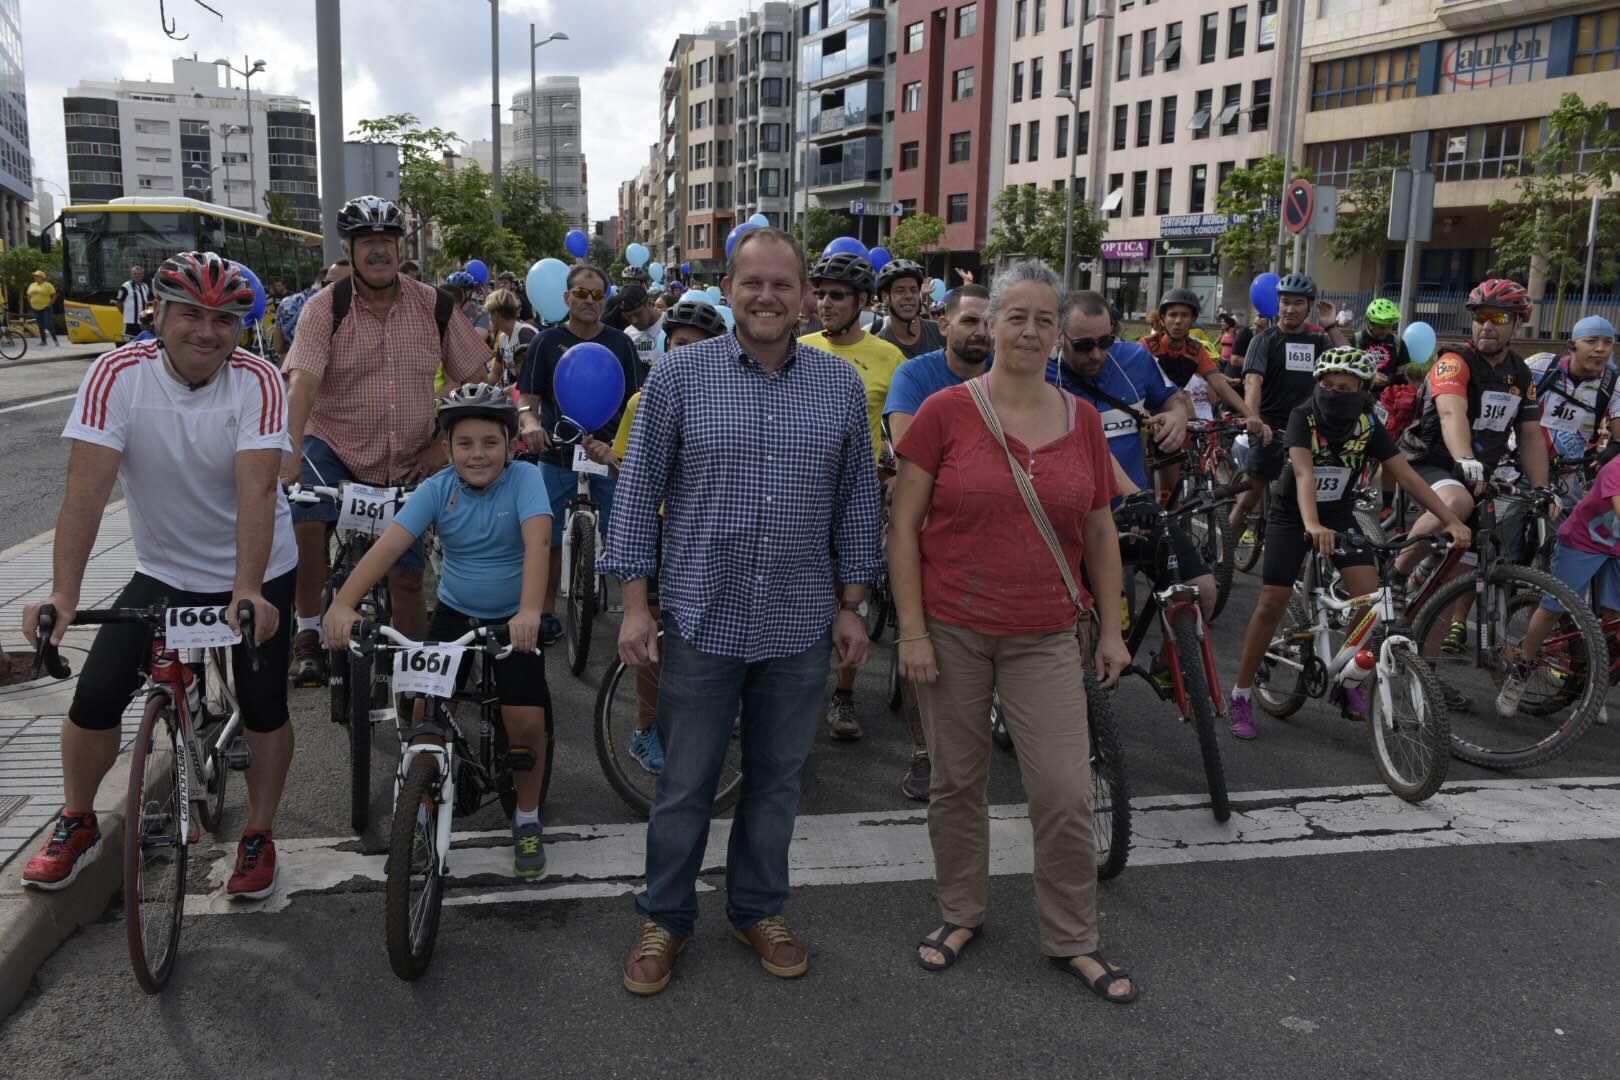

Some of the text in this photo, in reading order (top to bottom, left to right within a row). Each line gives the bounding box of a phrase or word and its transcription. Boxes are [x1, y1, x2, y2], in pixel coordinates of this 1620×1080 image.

[1460, 39, 1542, 69] auren
[1101, 241, 1143, 252] OPTICA
[1288, 351, 1312, 362] 1638
[1314, 477, 1339, 491] 153
[350, 498, 385, 520] 1361
[401, 650, 452, 676] 1661
